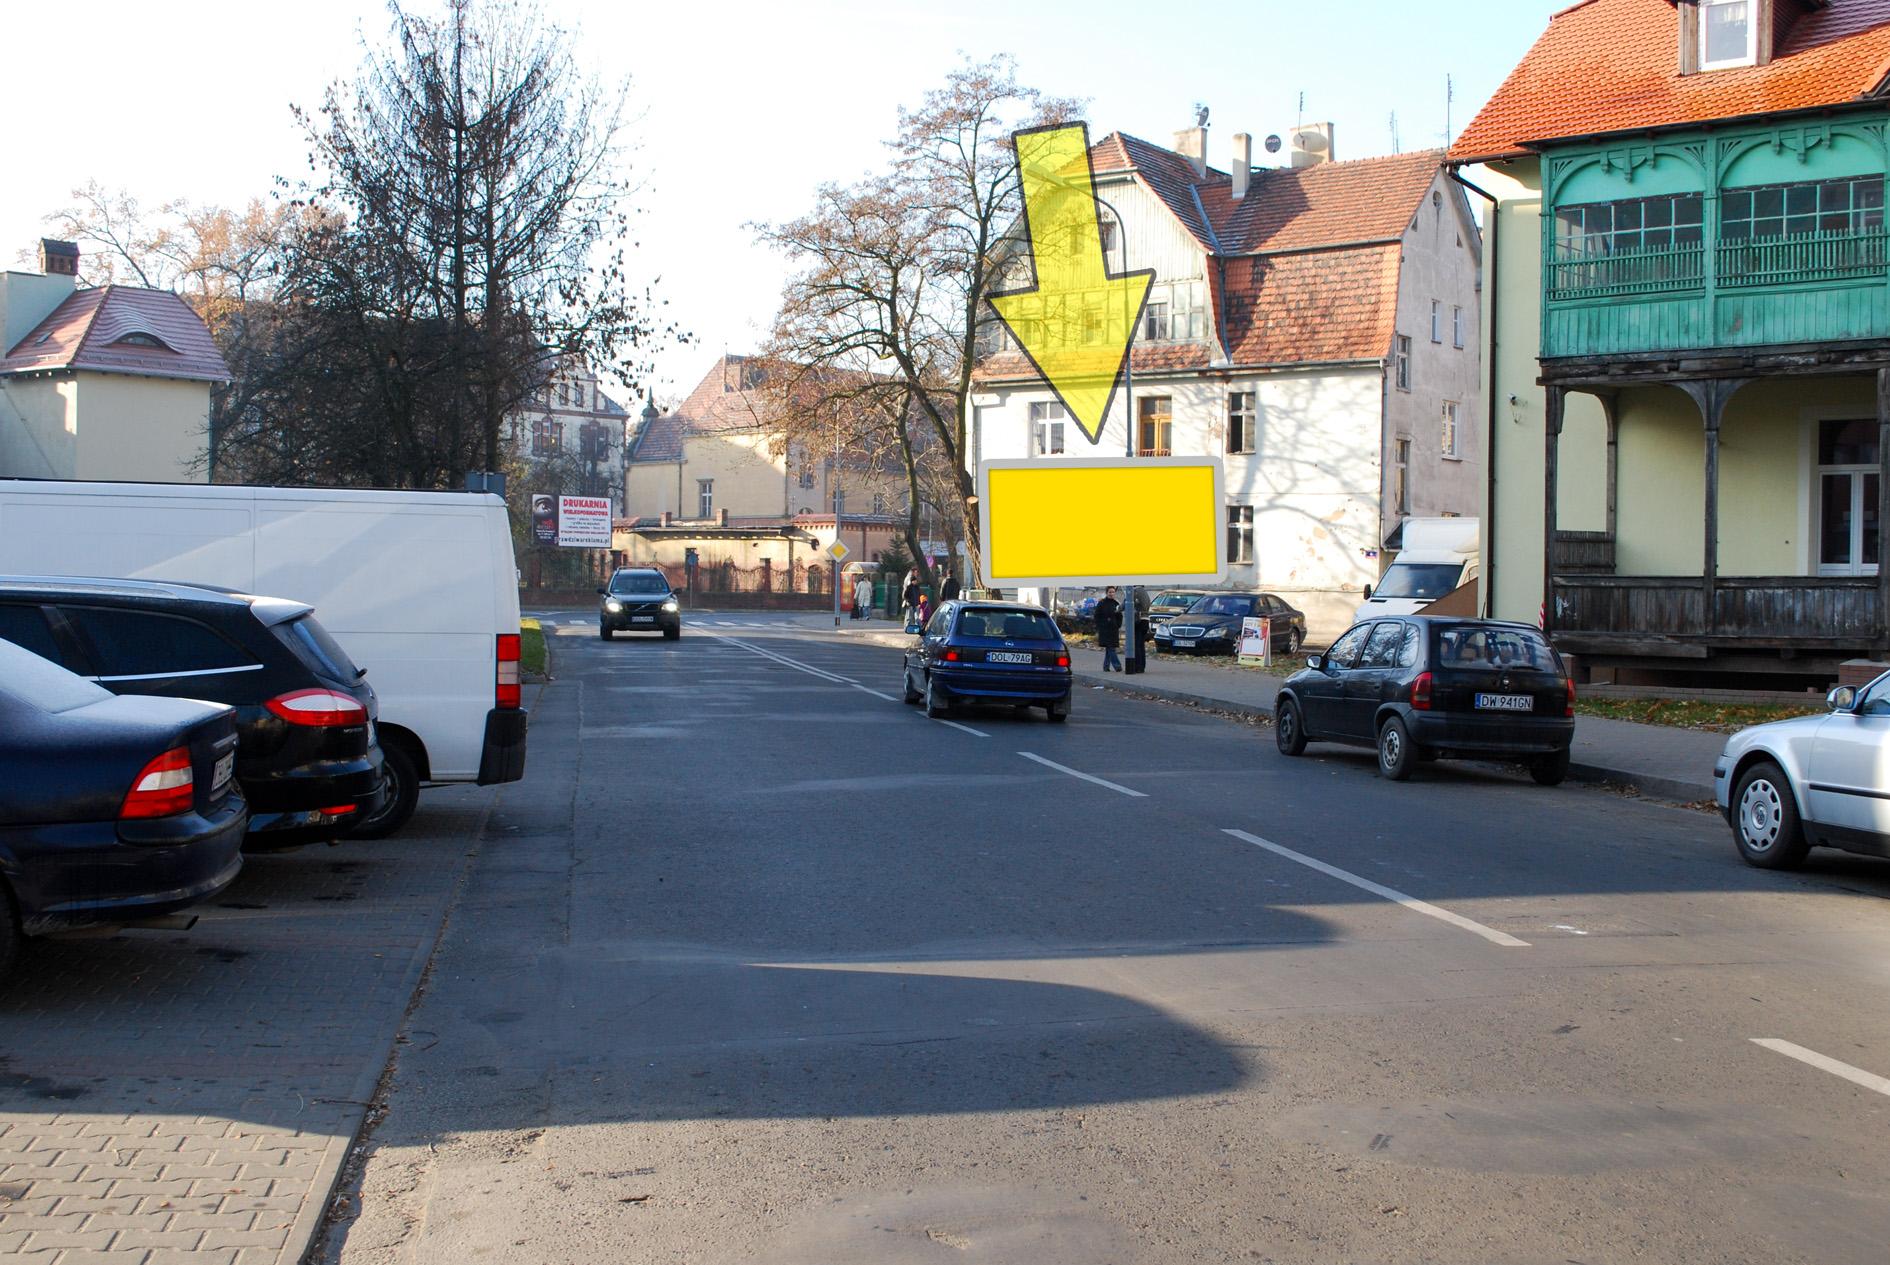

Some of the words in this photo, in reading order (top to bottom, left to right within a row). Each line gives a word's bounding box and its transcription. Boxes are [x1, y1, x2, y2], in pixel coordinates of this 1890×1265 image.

[563, 498, 608, 509] DRUKARNIA
[991, 652, 1009, 662] DOL
[1481, 695, 1497, 707] DW
[1500, 697, 1531, 708] 941GN
